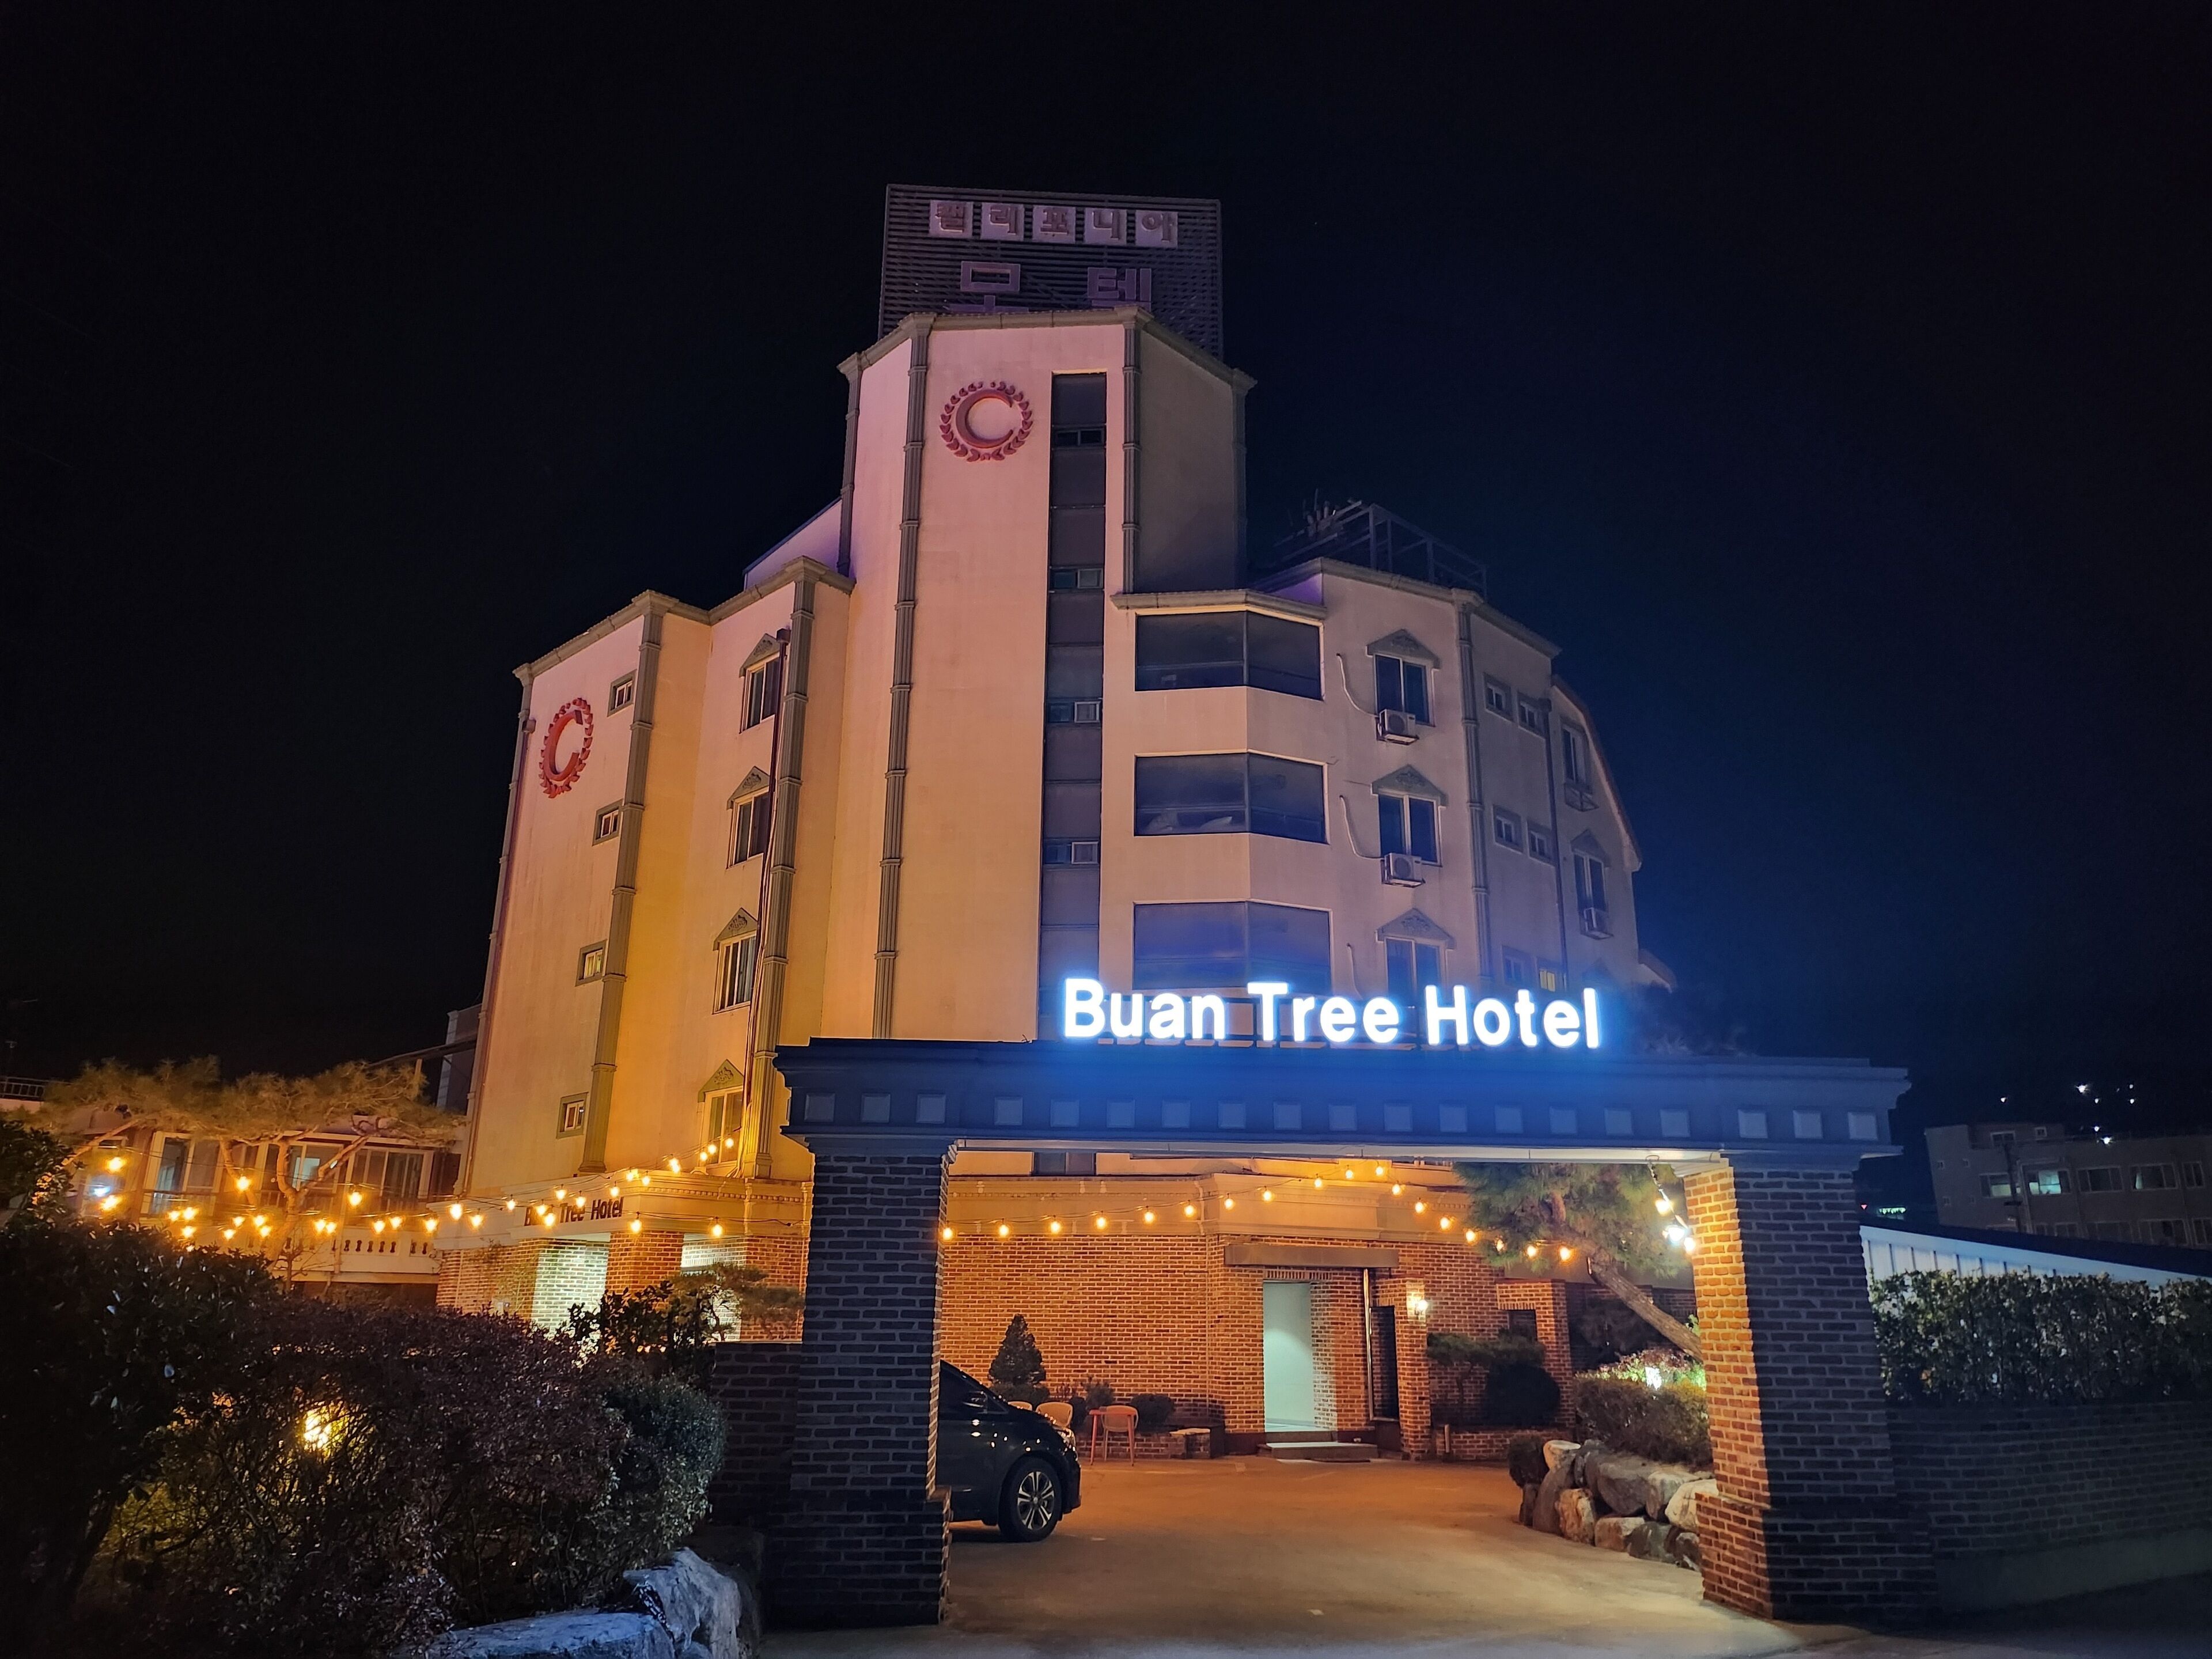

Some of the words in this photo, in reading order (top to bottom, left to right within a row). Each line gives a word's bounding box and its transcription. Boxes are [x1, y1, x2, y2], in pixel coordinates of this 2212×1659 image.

[934, 202, 1176, 243] 캘리포니아
[1063, 978, 1226, 1039] Buan
[1247, 982, 1399, 1043] Tree
[1425, 984, 1601, 1048] Hotel
[560, 1202, 585, 1223] Tree
[590, 1196, 624, 1220] Hotel
